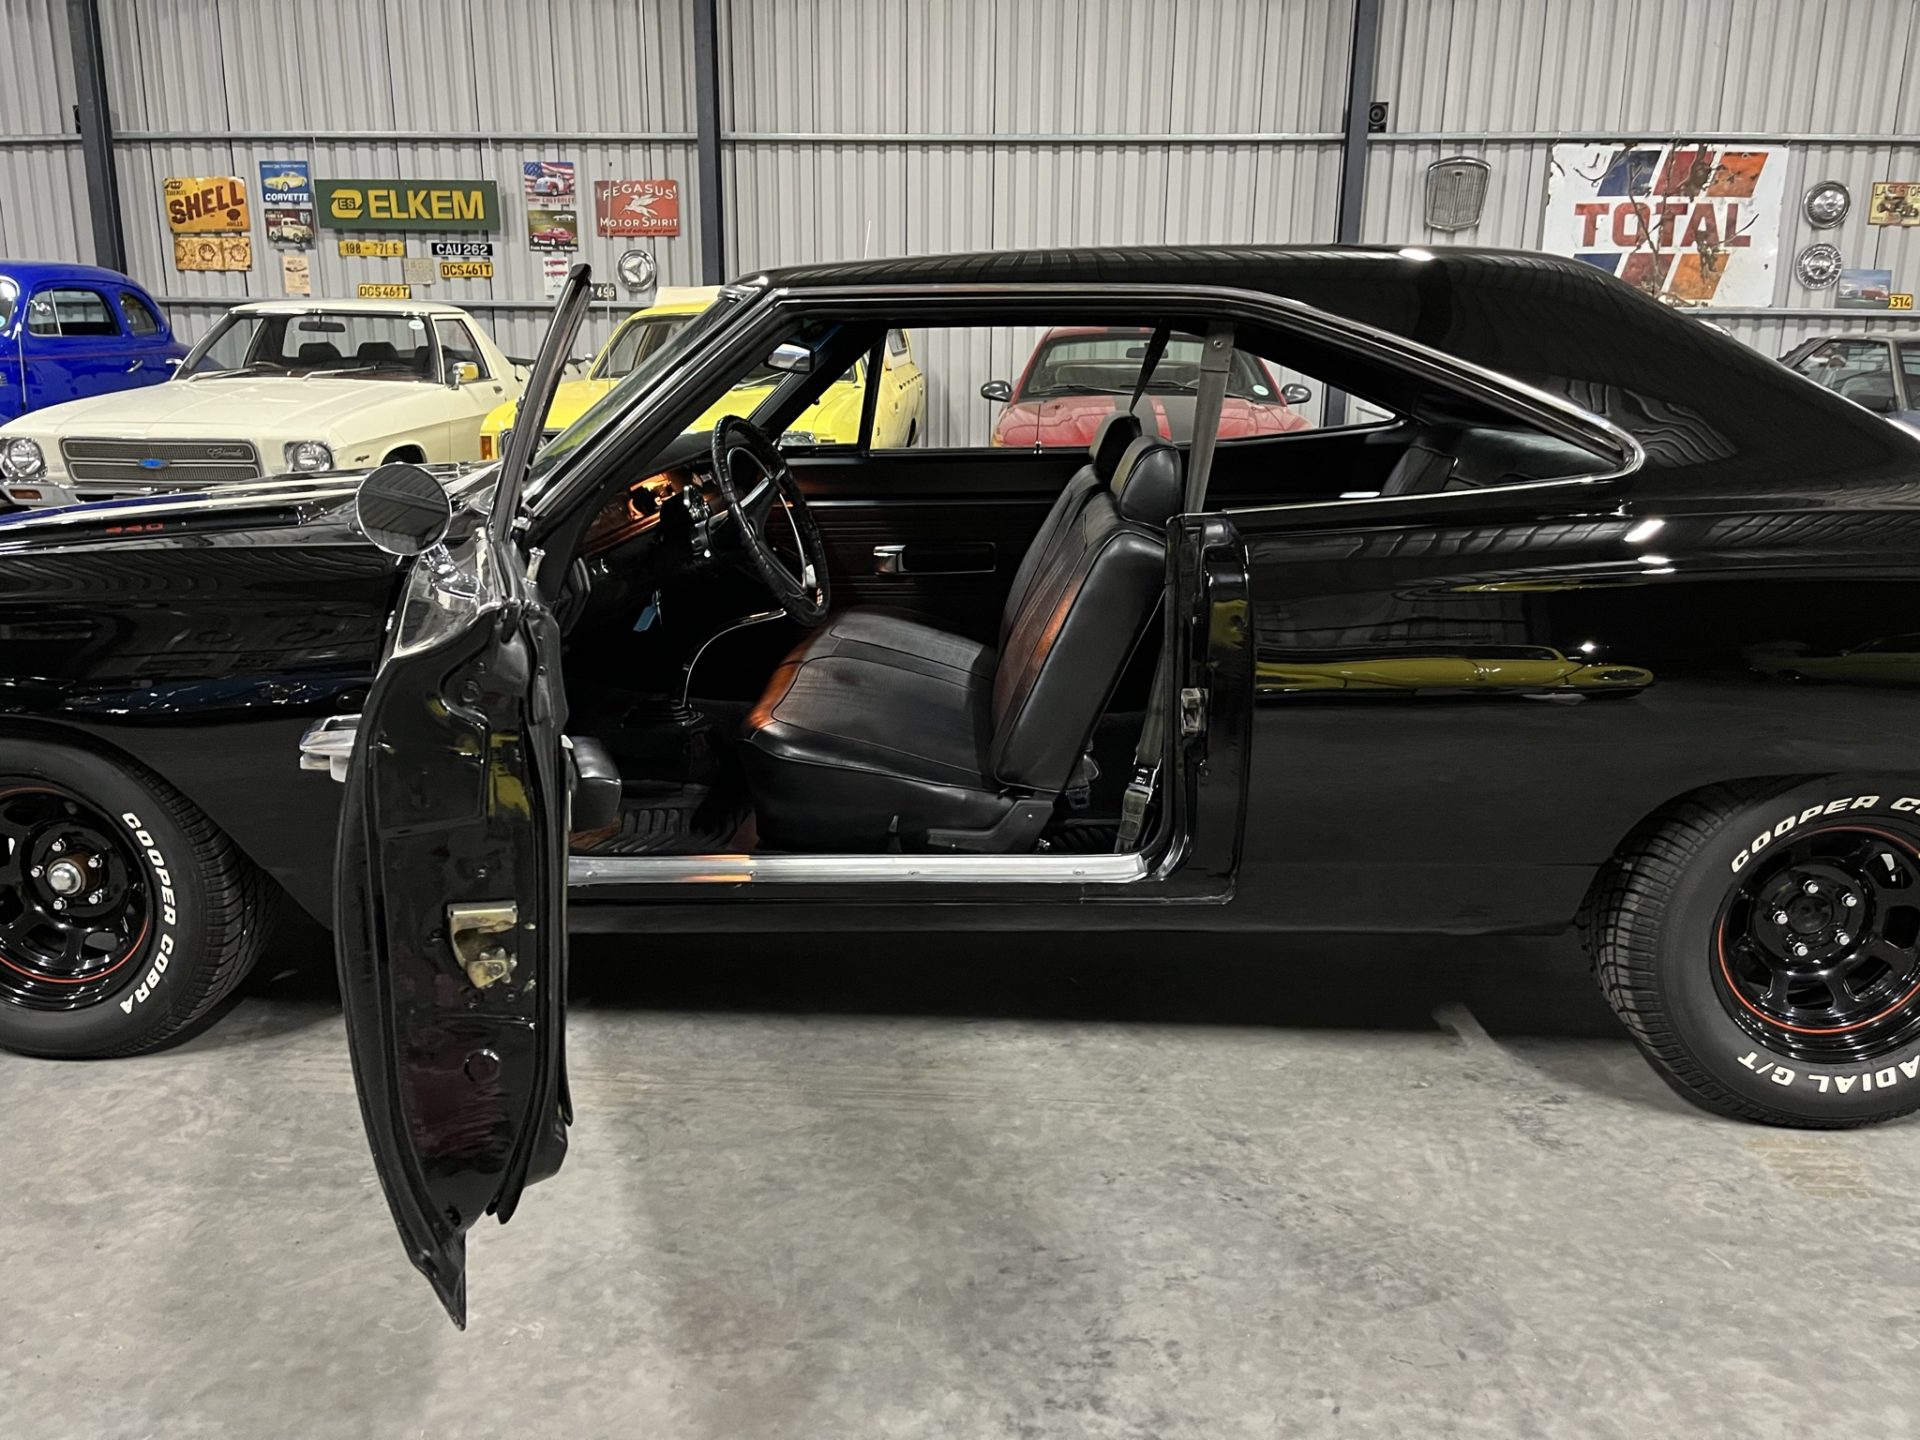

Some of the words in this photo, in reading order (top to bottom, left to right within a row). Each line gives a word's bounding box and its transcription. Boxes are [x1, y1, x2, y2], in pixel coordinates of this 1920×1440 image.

[169, 182, 244, 224] SHELL
[265, 193, 309, 201] CORVETTE
[339, 199, 355, 209] ES
[367, 189, 484, 219] ELKEM
[600, 218, 639, 227] MOTOR
[642, 217, 677, 227] SPIRIT
[1574, 202, 1752, 247] TOTAL
[1731, 795, 1880, 874] COOPER
[1890, 797, 1920, 815] C
[122, 812, 177, 926] COOPER
[120, 933, 174, 1014] COBRA
[1737, 1050, 1796, 1086] G/T
